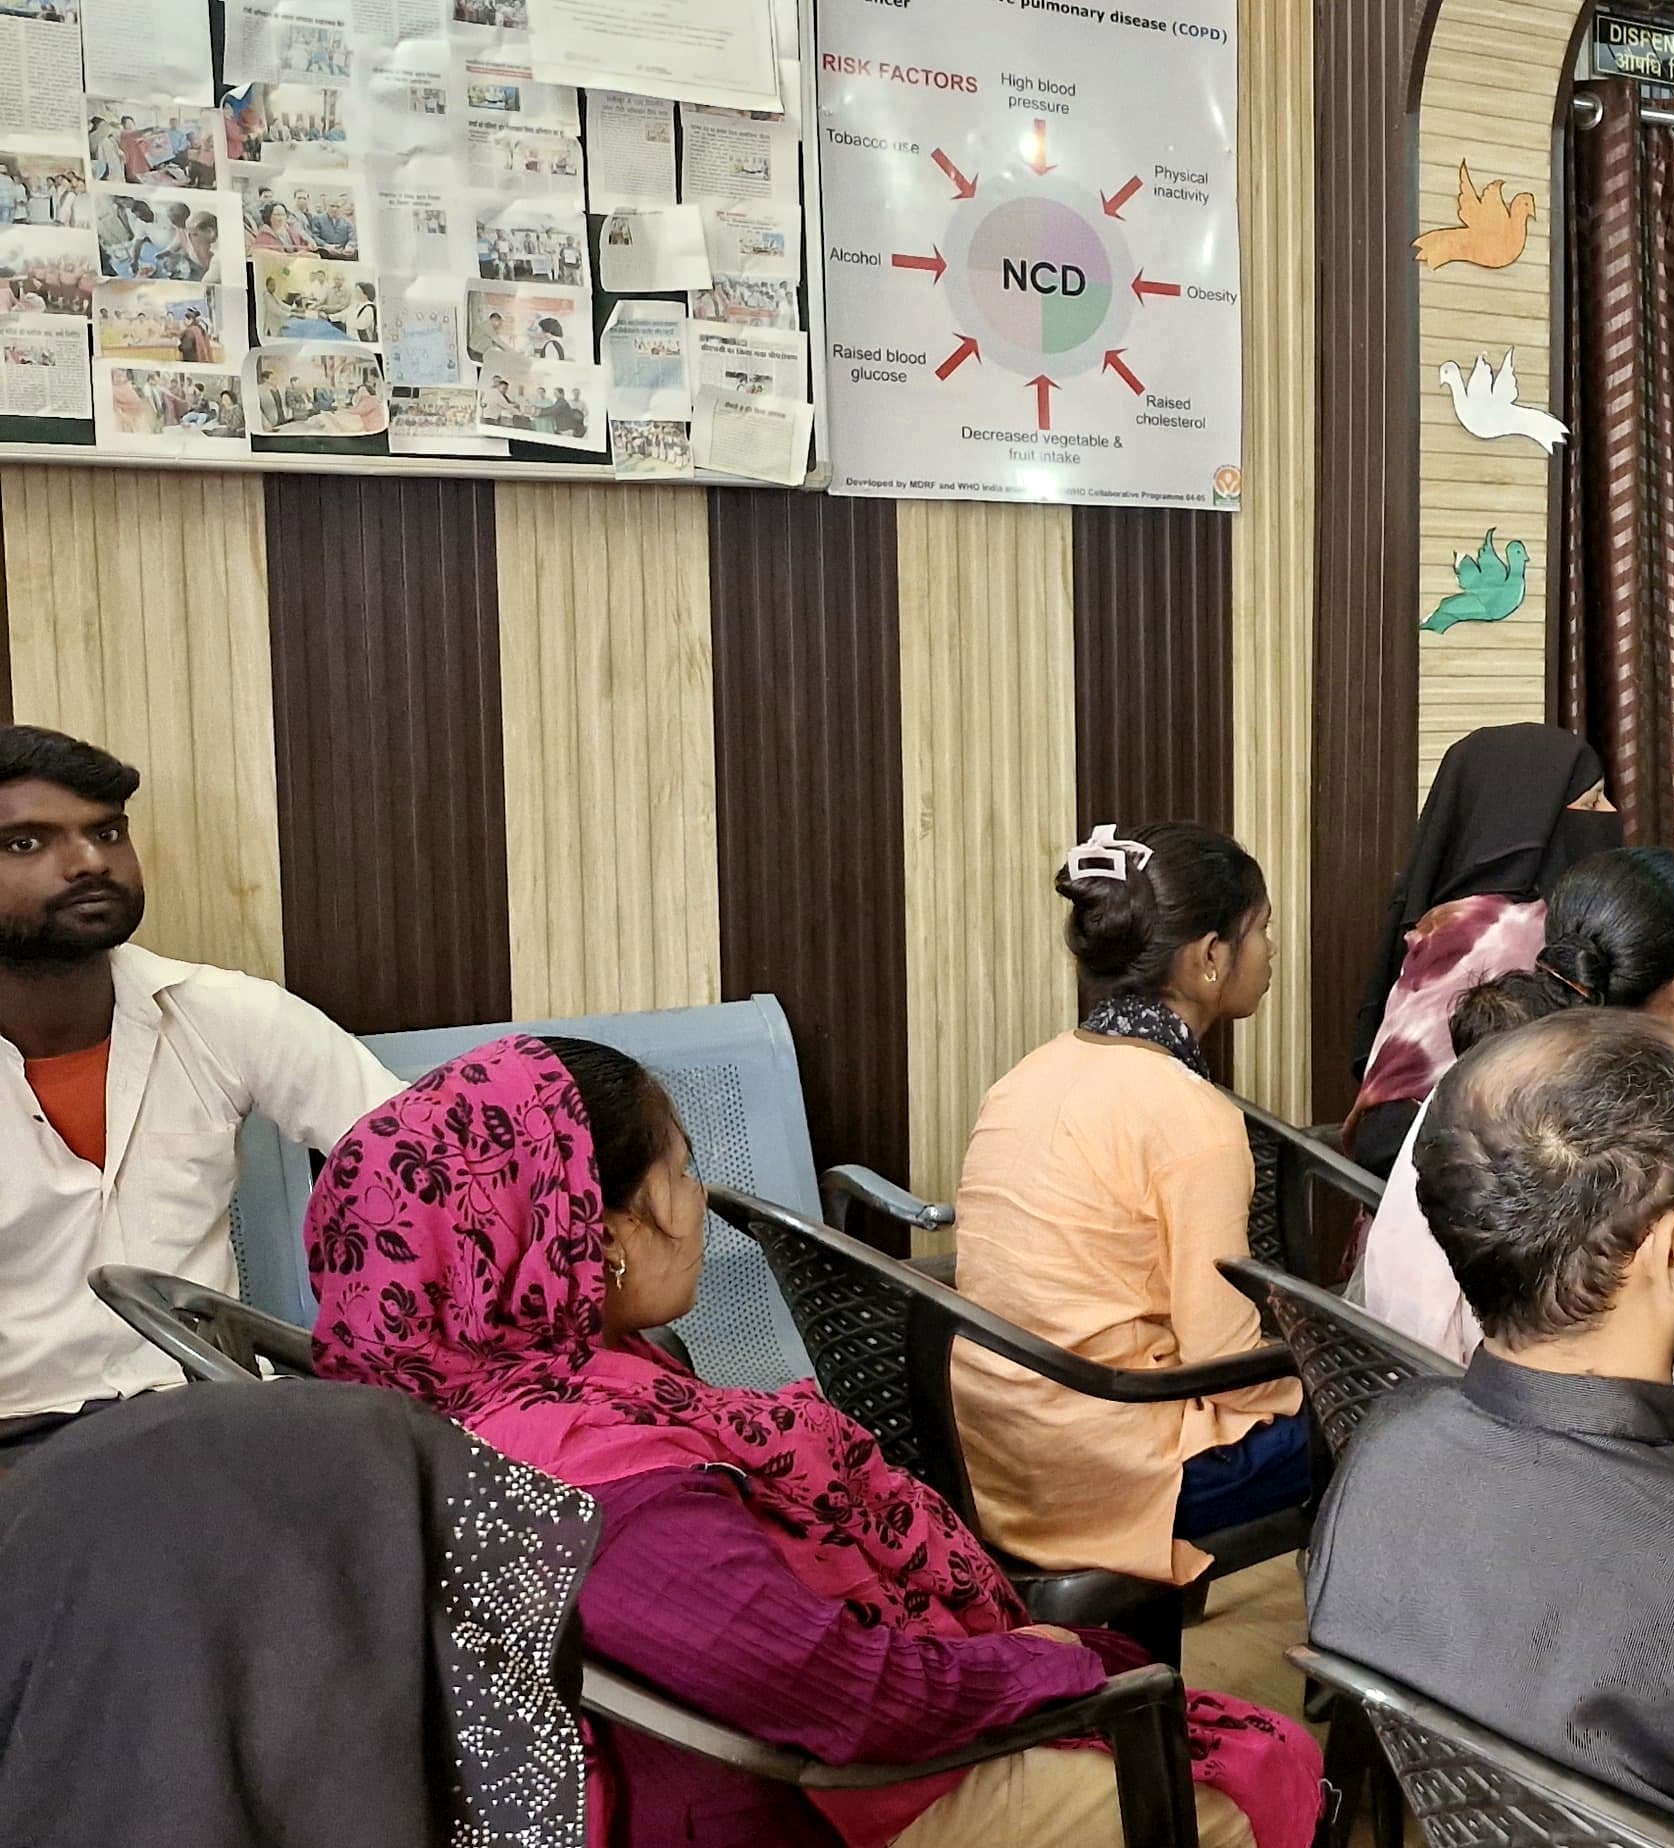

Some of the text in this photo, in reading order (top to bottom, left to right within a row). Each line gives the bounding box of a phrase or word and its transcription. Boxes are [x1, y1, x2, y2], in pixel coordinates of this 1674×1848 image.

[1020, 0, 1228, 45] pulmonary disease (COPD)
[822, 53, 978, 94] RISK FACTORS
[1000, 72, 1076, 97] High blood
[1007, 95, 1070, 115] pressure
[826, 128, 920, 154] Tobacco use
[1154, 165, 1209, 185] Physical
[1153, 185, 1210, 206] inactivity
[829, 247, 882, 266] Alcohol
[1003, 258, 1086, 297] NCD
[1187, 286, 1238, 305] Obesity
[833, 344, 927, 365] Raised blood
[851, 367, 907, 383] glucose
[1146, 394, 1191, 411] Raised
[1135, 413, 1206, 430] cholesterol
[961, 426, 1123, 450] Decreased vegetable &
[1009, 448, 1081, 465] fruit intake
[846, 477, 893, 489] Developed
